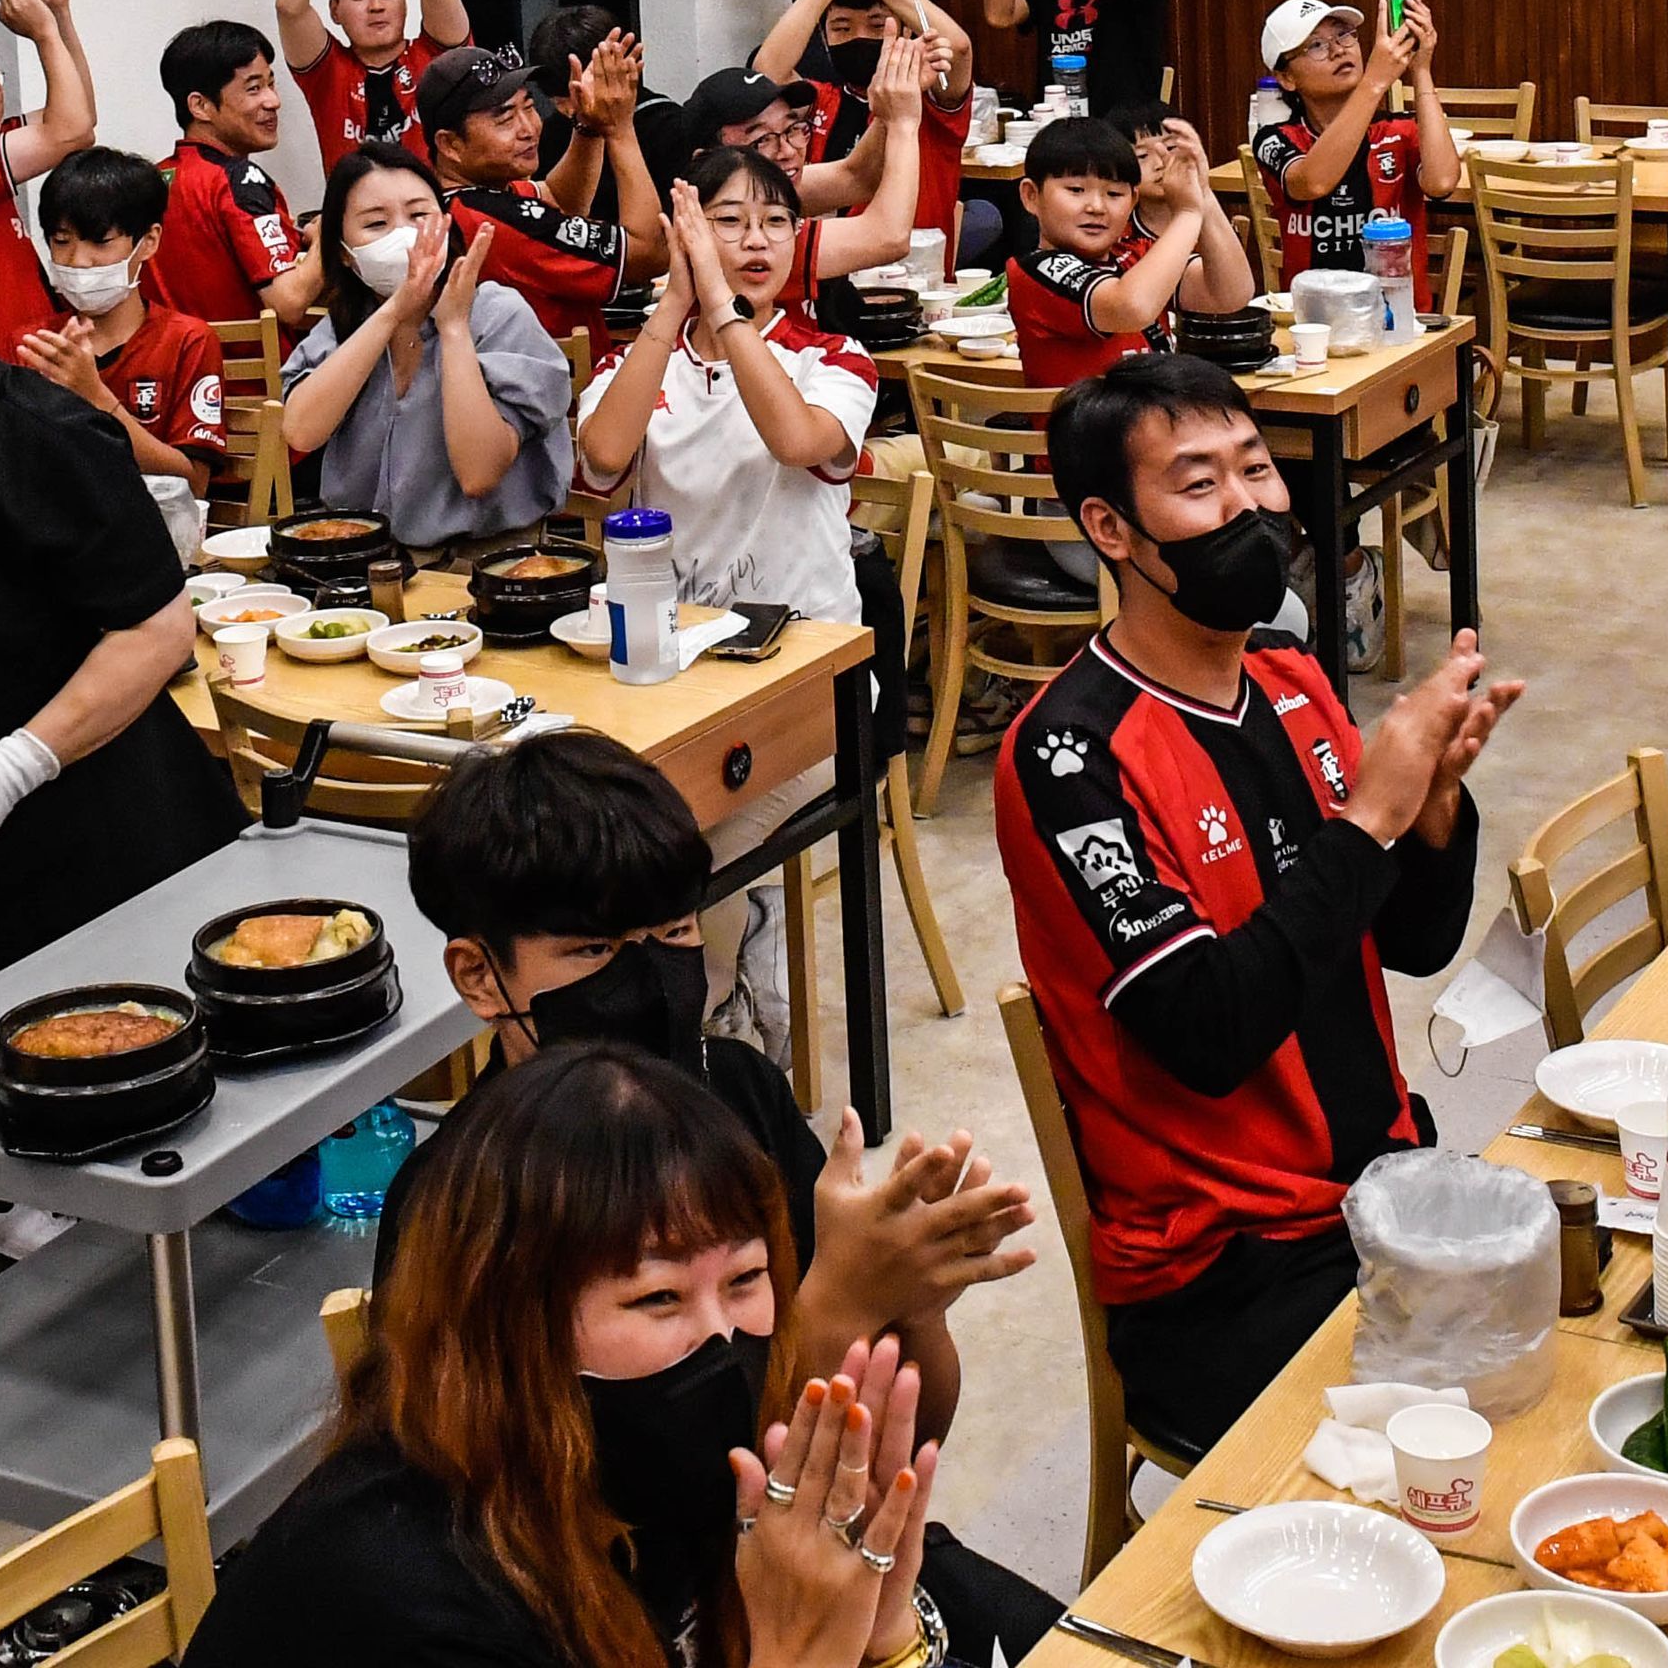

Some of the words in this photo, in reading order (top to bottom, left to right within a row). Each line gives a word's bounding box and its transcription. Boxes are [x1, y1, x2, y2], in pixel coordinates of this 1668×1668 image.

[1051, 43, 1088, 54] ARMO
[1317, 238, 1364, 254] CIT
[1201, 837, 1243, 864] KELME
[1099, 872, 1158, 909] 부천
[1407, 1486, 1472, 1512] 쉐프큐
